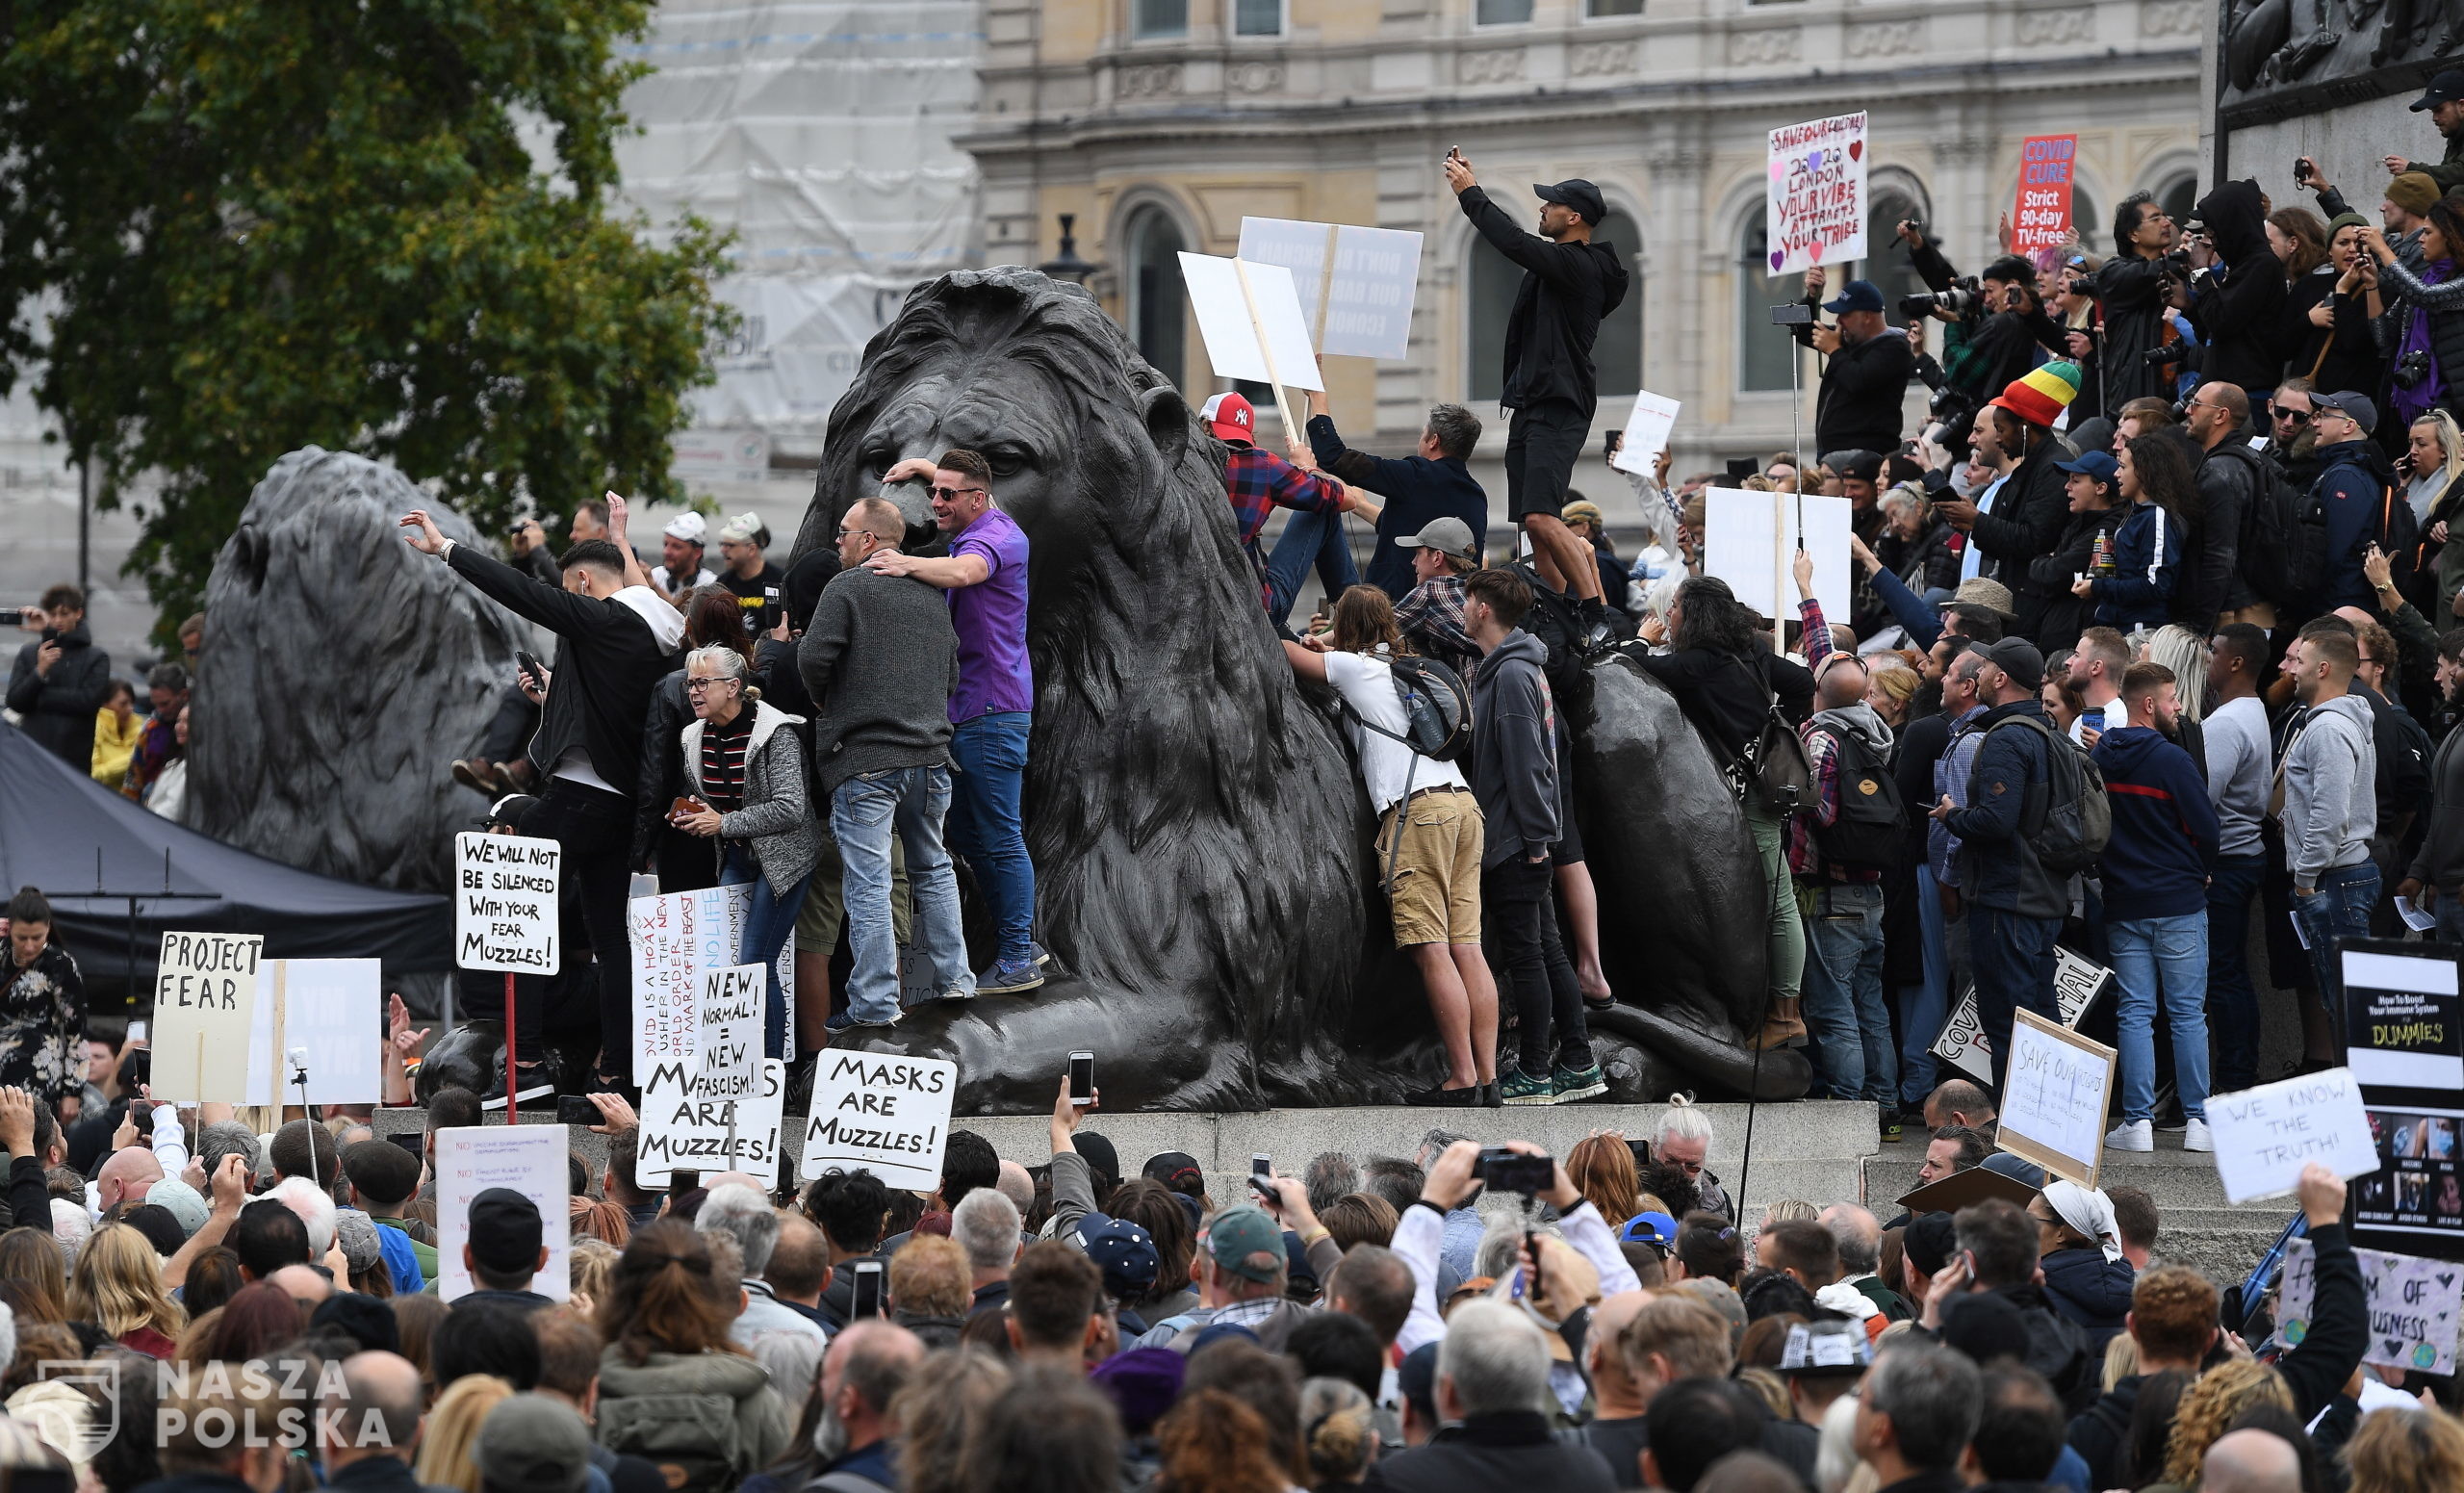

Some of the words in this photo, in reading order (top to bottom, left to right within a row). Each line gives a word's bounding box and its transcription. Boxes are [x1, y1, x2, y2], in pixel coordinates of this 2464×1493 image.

[2024, 139, 2074, 162] COVID
[1788, 164, 1844, 194] LONDON
[2025, 162, 2068, 184] CURE
[1777, 190, 1818, 227] YOUR
[1821, 179, 1856, 211] VIBE
[2024, 190, 2060, 208] Strict
[1790, 196, 1857, 235] ATTRACTS
[2020, 208, 2064, 229] 90-day
[1781, 227, 1819, 259] YOUR
[1821, 219, 1860, 247] TRIBE
[2017, 226, 2066, 245] TV-free
[464, 836, 494, 863] WE
[497, 844, 525, 863] WILL
[529, 847, 558, 870] NOT
[463, 869, 483, 888] BE
[491, 872, 554, 894] SILENCED
[469, 895, 501, 917] WITH
[505, 900, 540, 921] YOUR
[656, 896, 667, 928] NEW
[680, 894, 694, 935] BEAST
[702, 889, 720, 937] LIFE
[491, 923, 525, 938] FEAR
[643, 915, 656, 969] HOAX
[163, 934, 262, 975] PROJECT
[462, 932, 552, 968] MUZZLES!
[659, 936, 668, 963] THE
[683, 937, 694, 956] THE
[706, 940, 720, 967] NO
[659, 971, 668, 987] IN
[671, 939, 681, 1006] ORDER
[684, 956, 694, 975] OF
[160, 974, 236, 1010] FEAR
[645, 976, 654, 988] A
[706, 971, 752, 999] NEW
[645, 992, 655, 1008] IS
[683, 979, 694, 1033] MARK
[702, 986, 758, 1027] NORMAL!
[2368, 1005, 2385, 1017] Your
[2385, 1004, 2415, 1016] Immune
[2415, 1003, 2440, 1017] System
[2377, 994, 2395, 1006] How
[2395, 993, 2404, 1005] To
[2404, 993, 2426, 1004] Boost
[659, 995, 669, 1051] USHER
[672, 1016, 682, 1057] ORLD
[2372, 1021, 2444, 1046] DUMMIES
[684, 1038, 695, 1057] ND
[706, 1043, 746, 1072] NEW
[2018, 1040, 2052, 1074] SAVE
[2054, 1058, 2077, 1081] OUR
[696, 1063, 755, 1099] FASCISM!
[830, 1056, 945, 1094] MASKS
[671, 1102, 739, 1126] ARE
[838, 1092, 897, 1117] ARE
[2225, 1098, 2268, 1121] WE
[2287, 1080, 2346, 1108] KNOW
[807, 1116, 937, 1155] MUZZLES!
[2266, 1114, 2312, 1136] THE
[455, 1142, 470, 1150] NO
[457, 1170, 472, 1178] NO
[2403, 1278, 2428, 1305] OF
